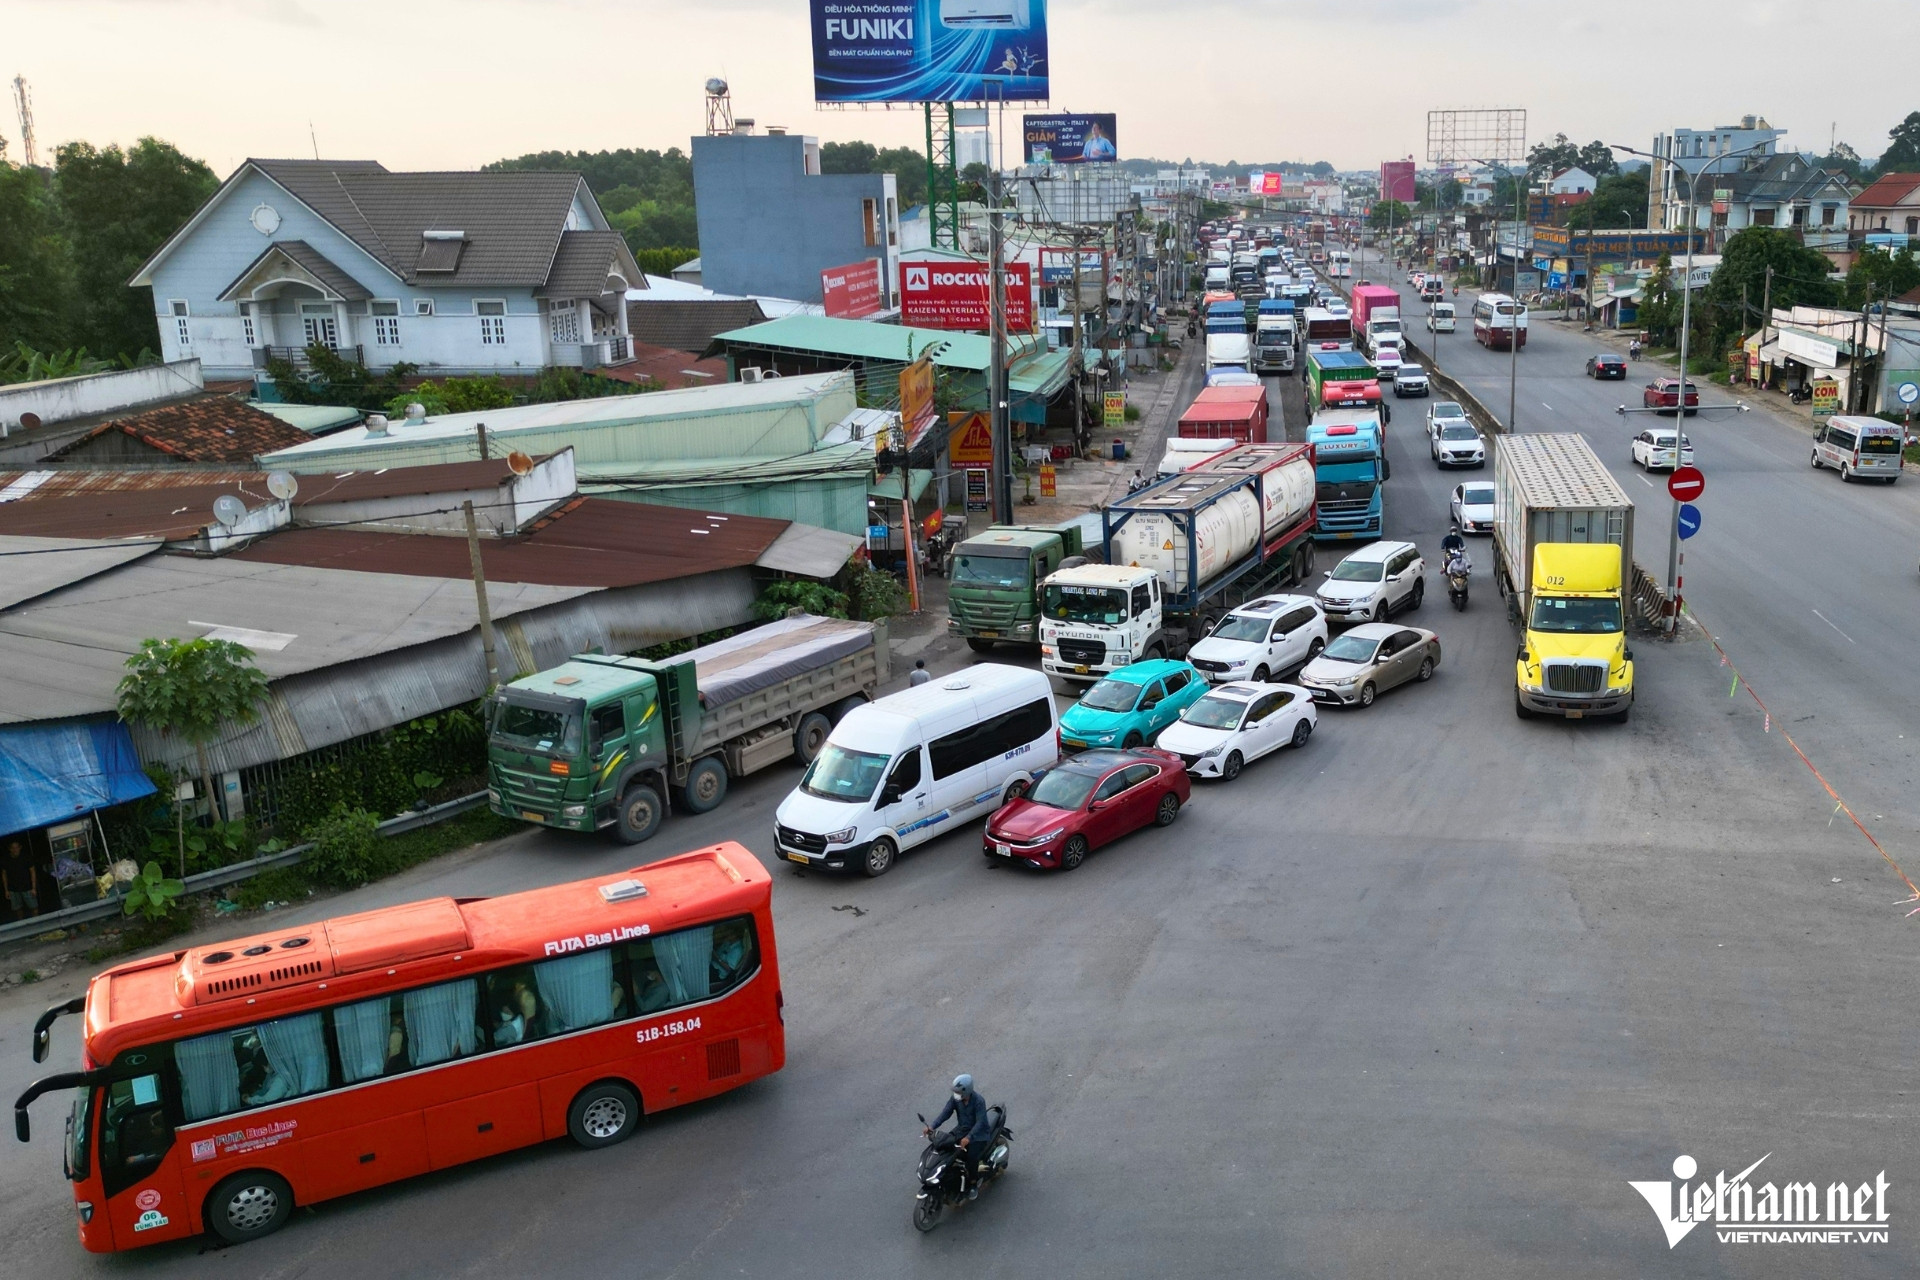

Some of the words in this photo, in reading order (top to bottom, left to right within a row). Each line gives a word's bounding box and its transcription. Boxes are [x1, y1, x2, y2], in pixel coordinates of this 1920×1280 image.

[891, 5, 913, 14] MINH
[825, 18, 914, 41] FUNIKI
[932, 272, 1024, 286] ROCKWOL
[907, 306, 937, 314] KAIZEN
[939, 306, 984, 314] MATERIALS
[1546, 576, 1565, 586] 012
[1057, 631, 1104, 640] HYUNDAI
[544, 937, 585, 957] FUTA
[585, 932, 613, 949] Bus
[612, 923, 651, 943] Lines
[636, 1016, 702, 1044] 51B-158.04
[216, 1131, 246, 1147] FUTA
[246, 1126, 268, 1140] Bus
[268, 1119, 298, 1135] Lines
[143, 1212, 157, 1221] 06
